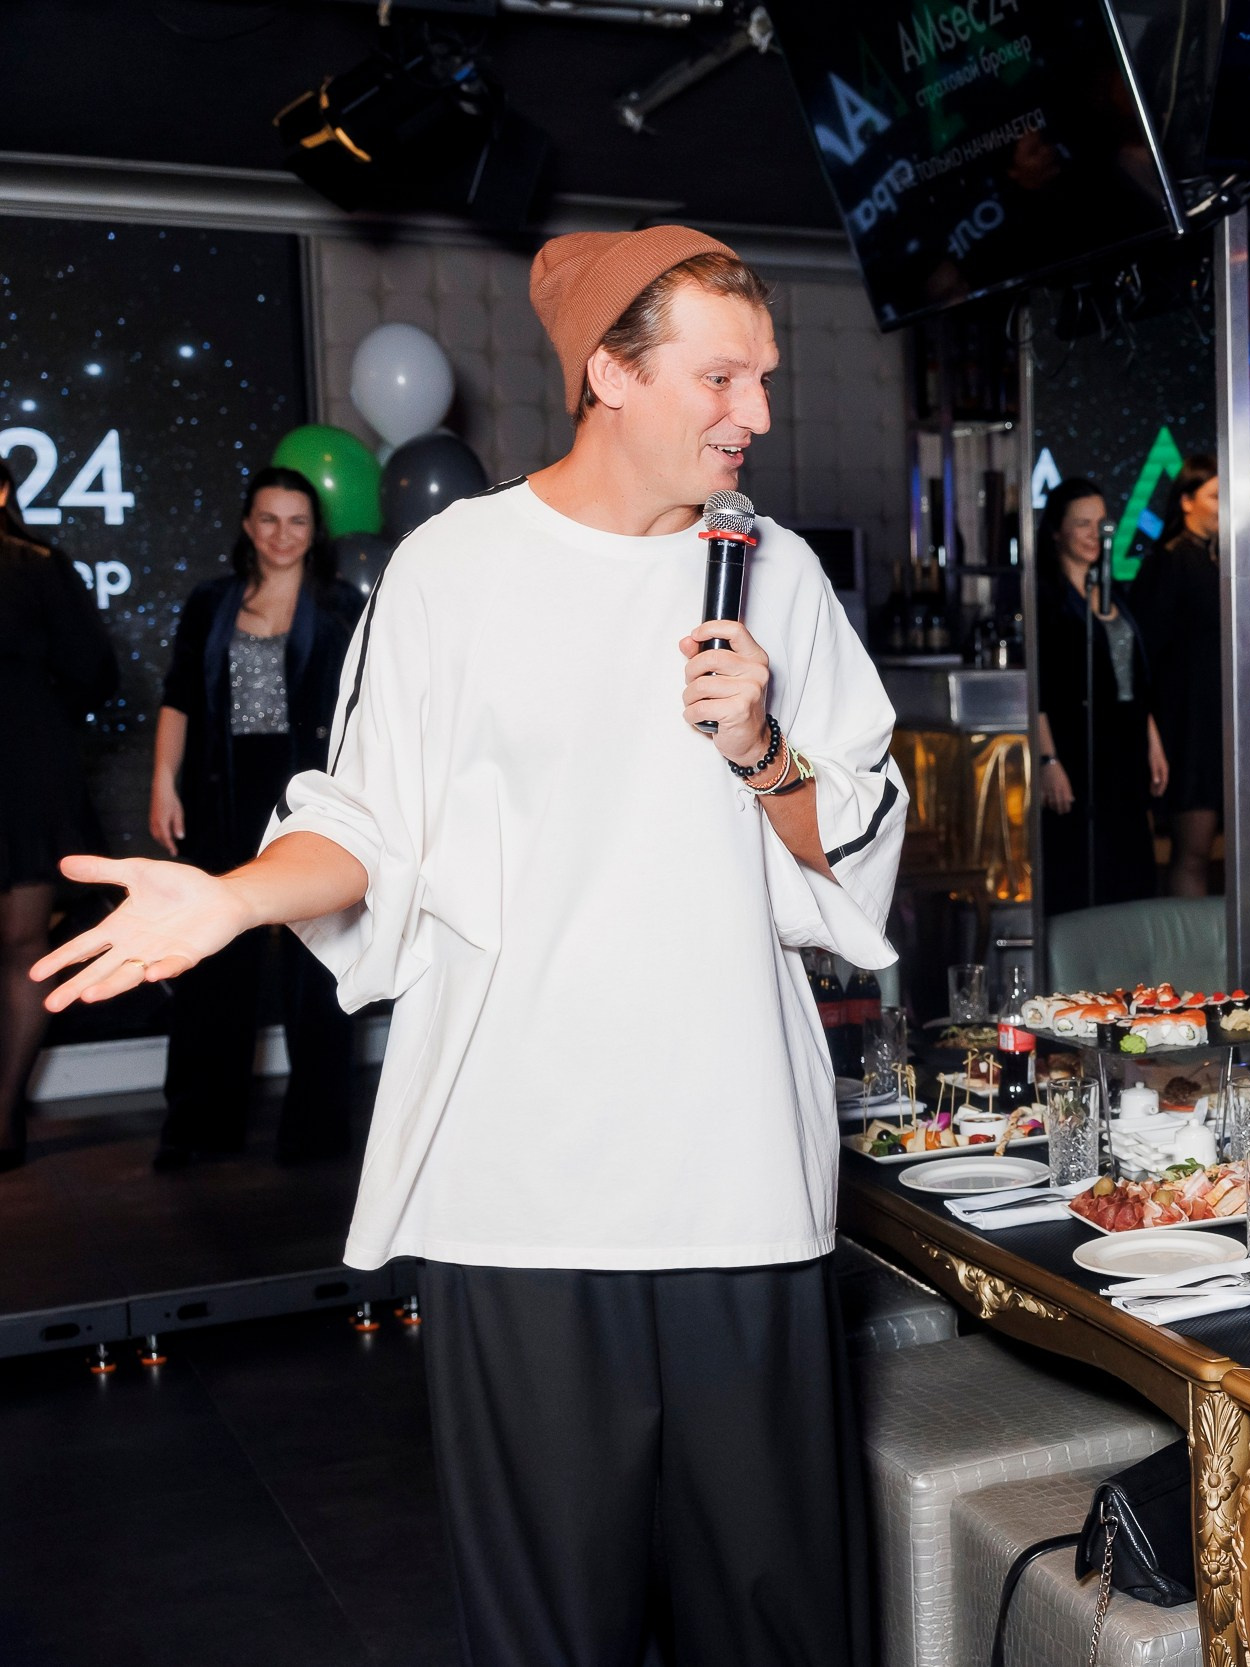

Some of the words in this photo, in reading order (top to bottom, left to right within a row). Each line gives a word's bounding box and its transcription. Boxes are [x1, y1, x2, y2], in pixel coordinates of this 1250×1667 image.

[897, 0, 1019, 73] AMsec2
[979, 34, 1032, 77] брокер
[962, 107, 1047, 161] НАЧИНАЕТСЯ
